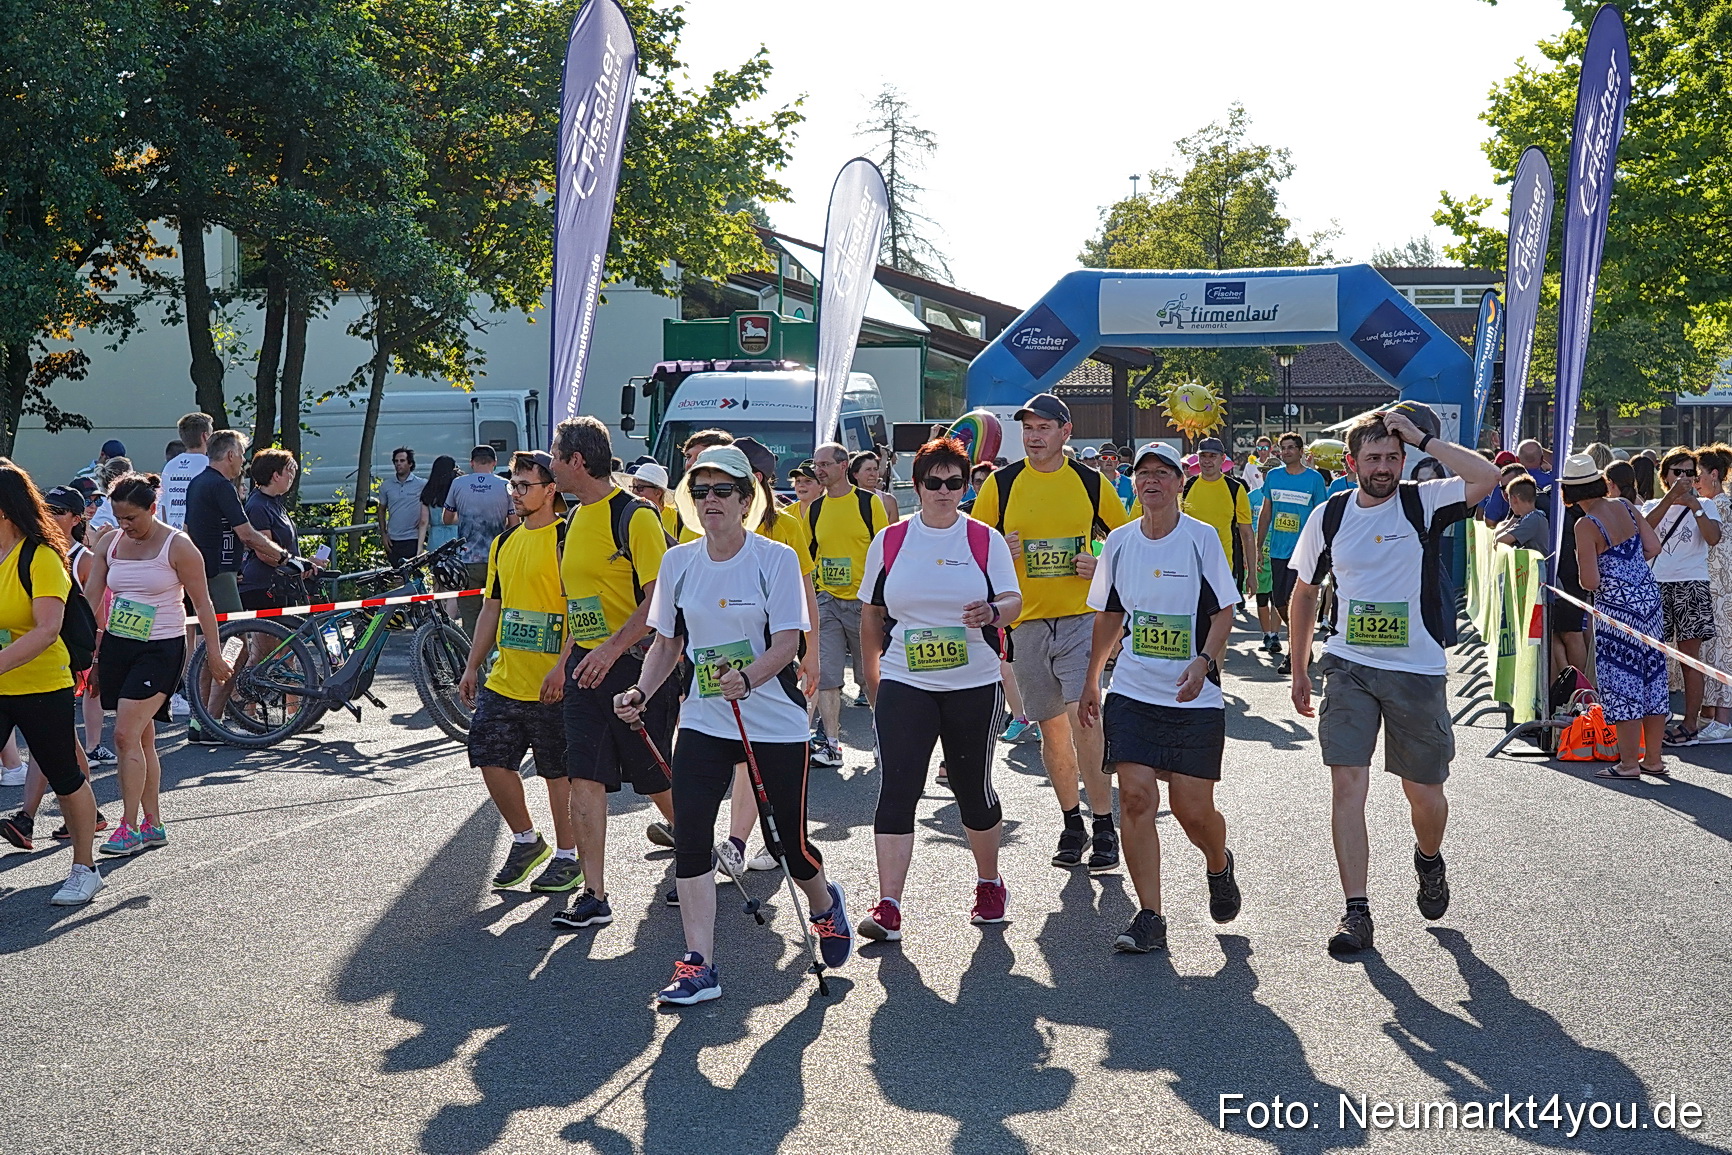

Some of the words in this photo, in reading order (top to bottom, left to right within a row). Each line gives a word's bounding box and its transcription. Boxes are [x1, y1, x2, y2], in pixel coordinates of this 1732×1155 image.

[581, 33, 616, 173] Fischer
[598, 55, 623, 167] AUTOMOBILE
[1588, 48, 1617, 189] Fischer
[1520, 173, 1541, 273] Fischer
[842, 185, 871, 280] Fischer
[1213, 289, 1243, 297] Fischer
[1191, 304, 1280, 322] firmenlauf
[1020, 335, 1069, 346] Fischer
[678, 399, 717, 408] abavent
[1279, 518, 1296, 527] 1433
[1033, 551, 1068, 565] 1257
[826, 567, 845, 577] 1274
[117, 611, 141, 627] 277
[572, 611, 598, 627] 1288
[597, 612, 607, 631] 2022
[1357, 616, 1399, 632] 1324
[142, 620, 151, 636] 2022
[506, 622, 538, 638] 1255
[1354, 632, 1377, 640] Scherer
[1141, 627, 1181, 646] 1317
[916, 641, 957, 658] 1316
[958, 643, 966, 662] 2022
[698, 668, 706, 691] WALK
